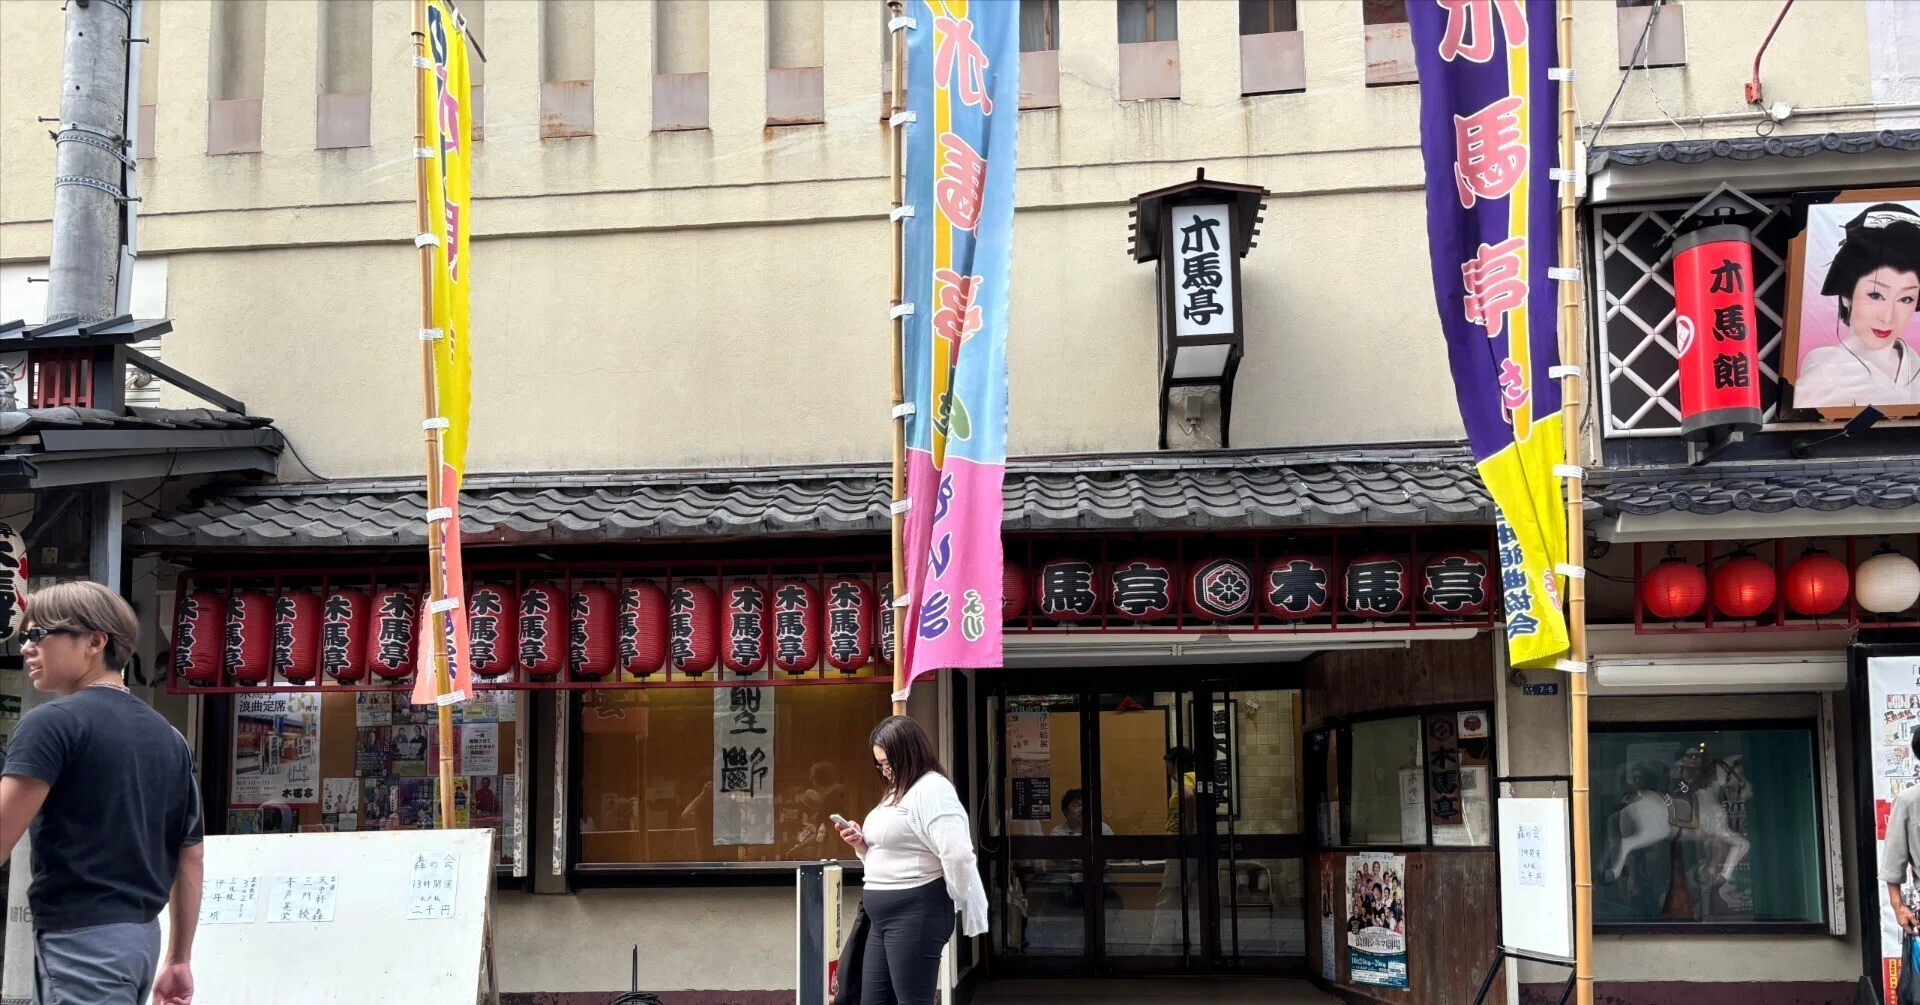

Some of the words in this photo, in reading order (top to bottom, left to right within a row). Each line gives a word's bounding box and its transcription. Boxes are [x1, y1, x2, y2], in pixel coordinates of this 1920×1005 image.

[1180, 214, 1224, 326] 木馬亭
[1709, 259, 1751, 390] 木馬館
[324, 595, 353, 674] 木馬亭
[378, 593, 415, 670] 木馬亭
[468, 589, 502, 668] 木馬亭
[518, 589, 550, 668] 木馬亭
[670, 587, 695, 667] 木馬亭
[729, 586, 764, 667] 木馬亭
[774, 585, 808, 665] 木馬亭
[828, 582, 862, 664] 木馬亭
[239, 700, 287, 713] 浪曲定席
[1430, 746, 1460, 820] 木馬亭
[411, 904, 450, 916] 二千円
